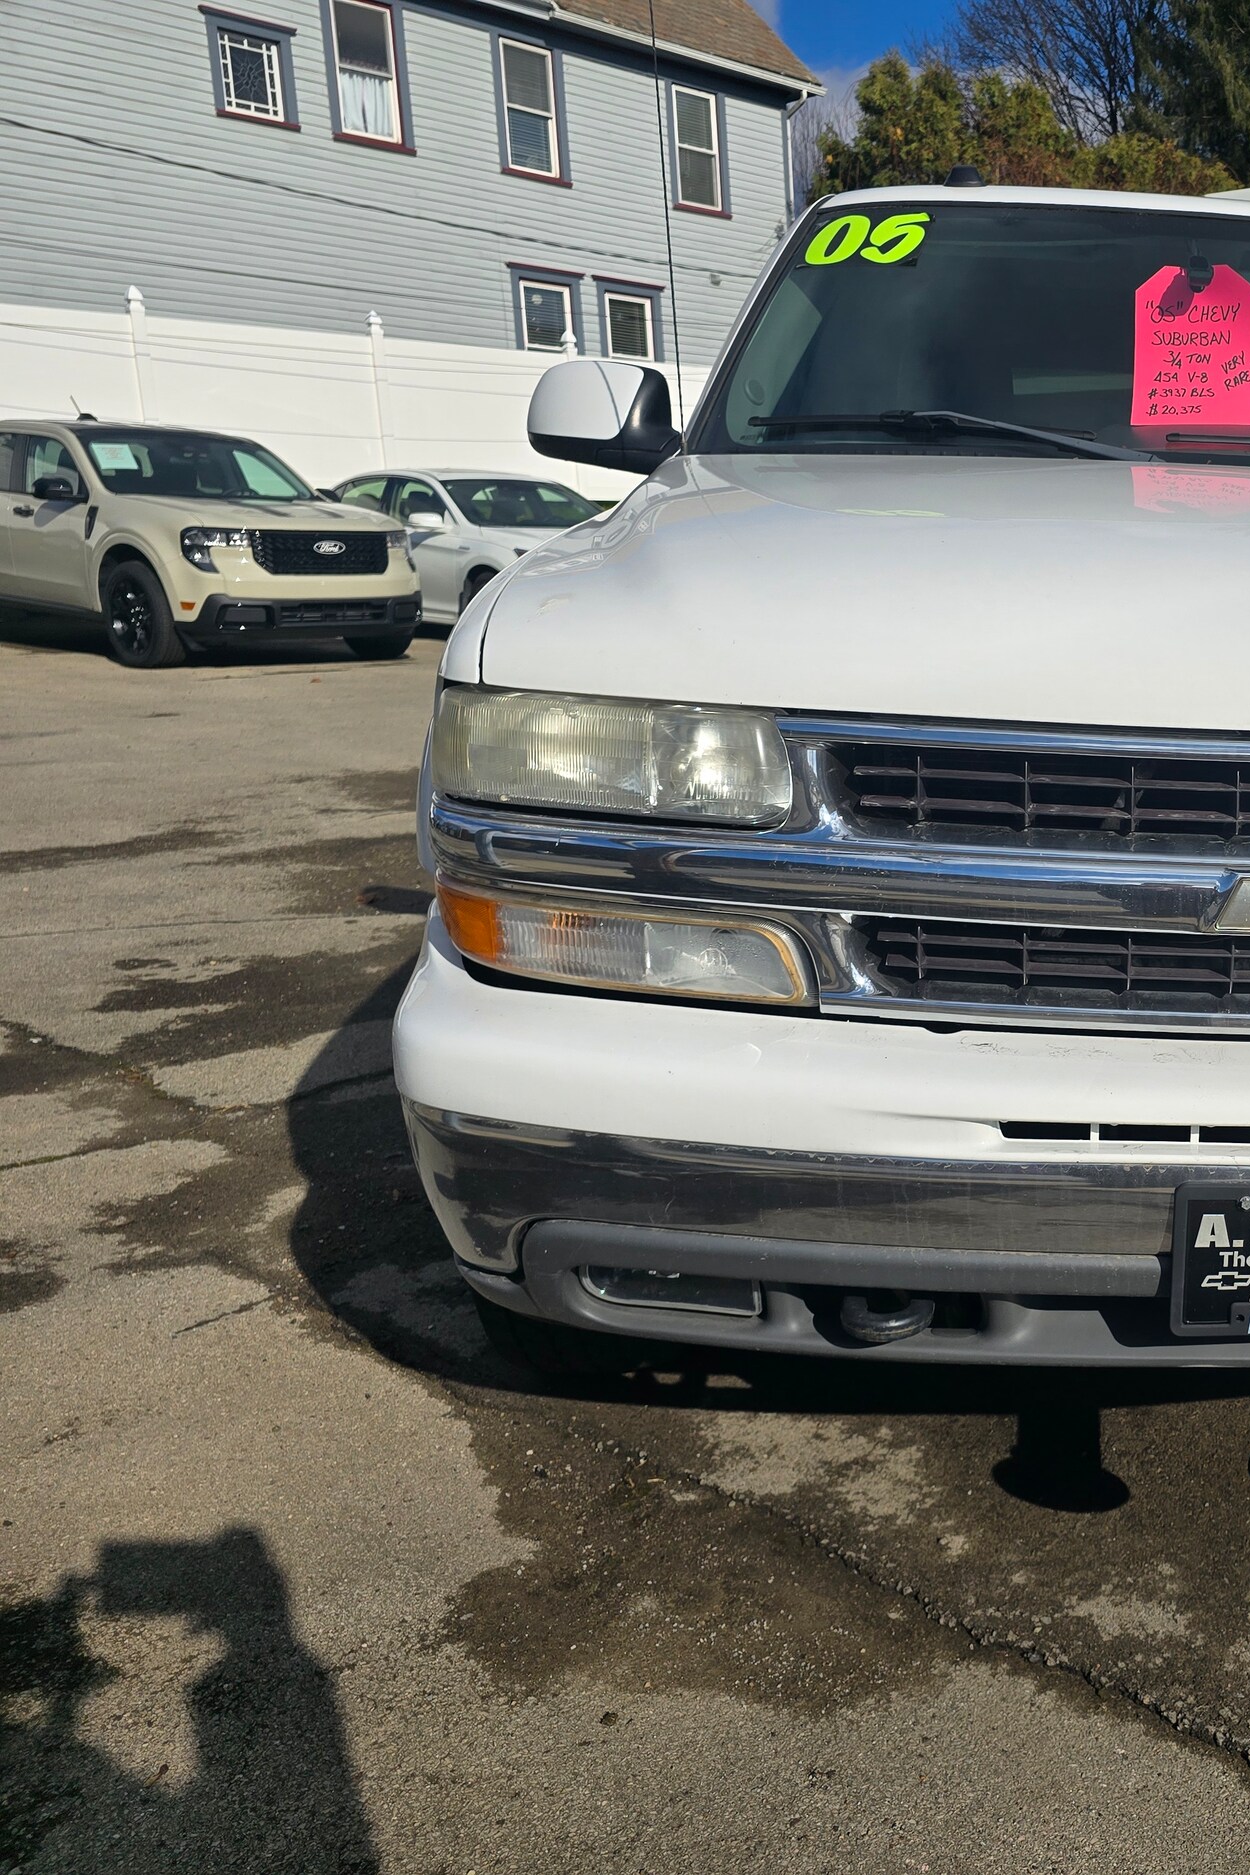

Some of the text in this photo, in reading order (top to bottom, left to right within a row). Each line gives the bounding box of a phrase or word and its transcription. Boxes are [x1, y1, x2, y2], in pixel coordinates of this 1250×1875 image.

[804, 212, 931, 265] 05
[1188, 302, 1241, 324] CHEVY
[1151, 330, 1231, 347] SUBURBAN
[1186, 353, 1211, 364] TON
[1221, 350, 1246, 374] VERY
[1153, 370, 1209, 383] 454 V-8
[1190, 388, 1215, 398] BLS
[1194, 1213, 1245, 1248] A.
